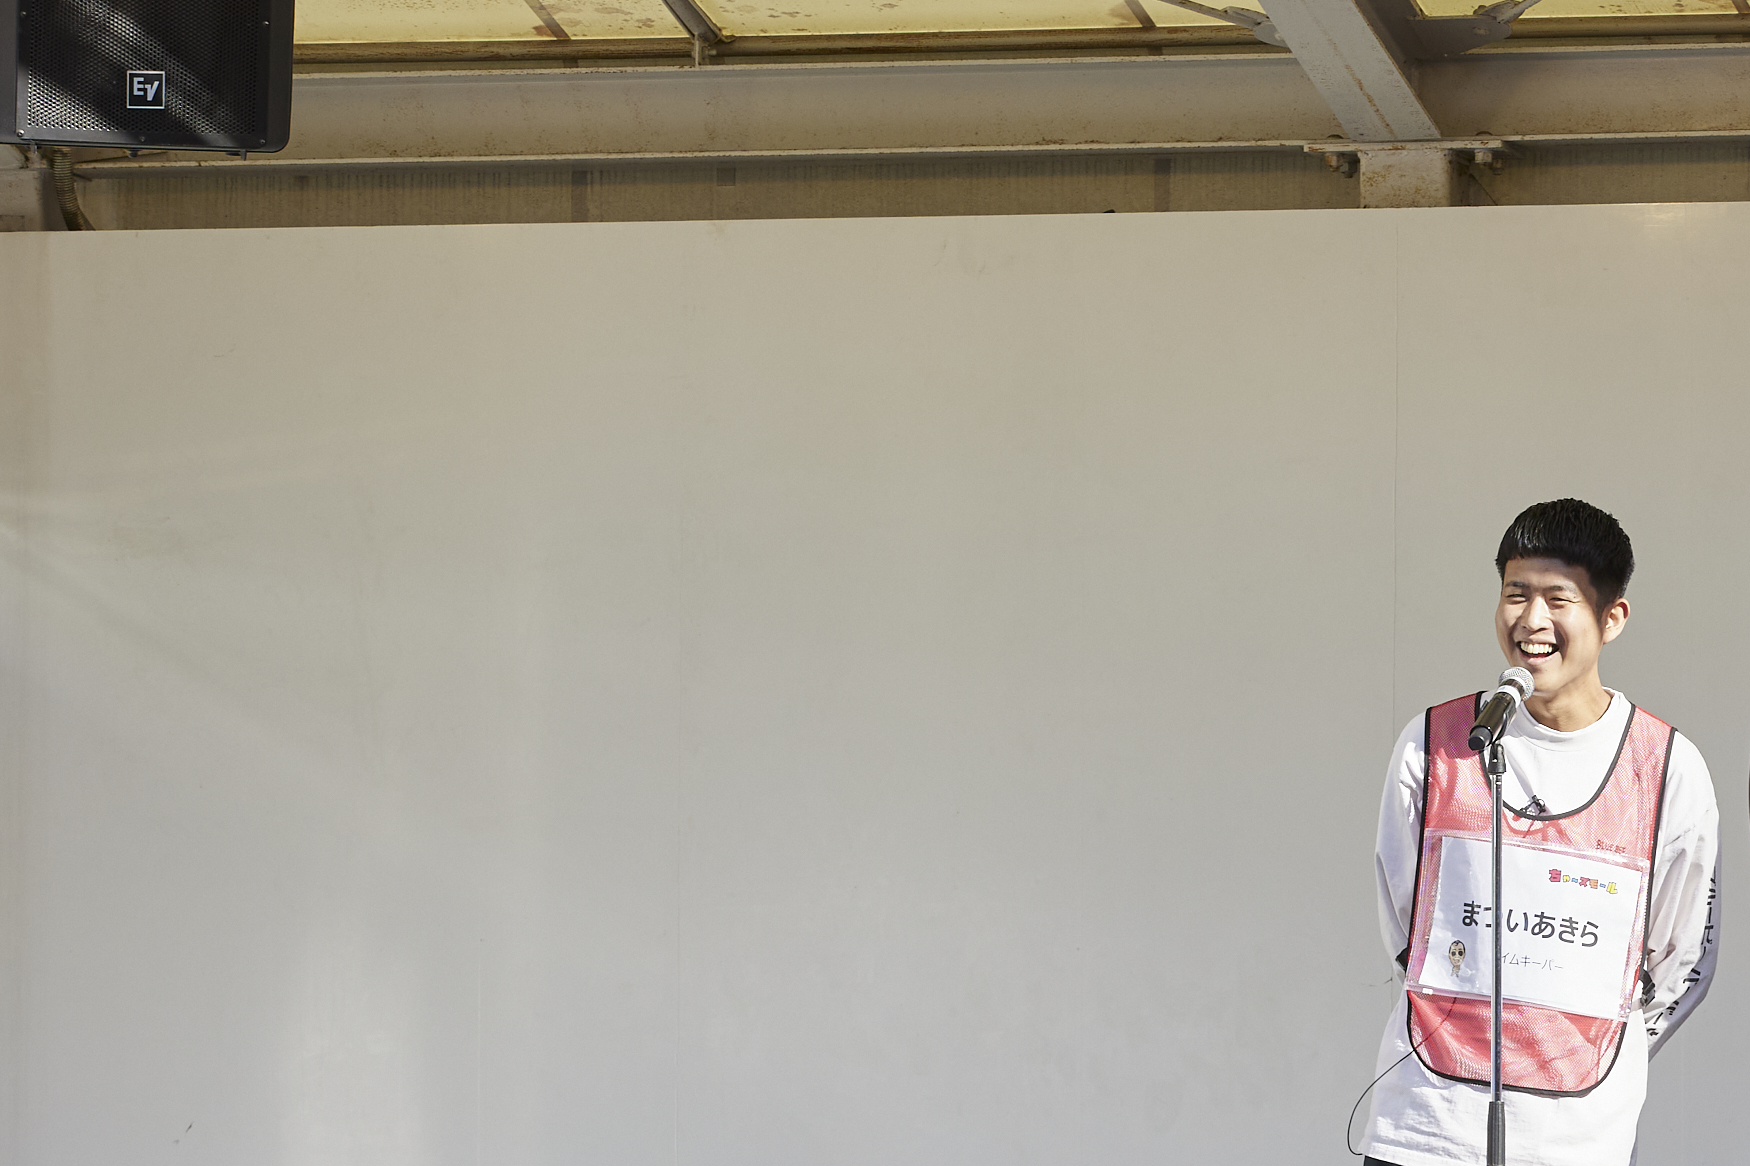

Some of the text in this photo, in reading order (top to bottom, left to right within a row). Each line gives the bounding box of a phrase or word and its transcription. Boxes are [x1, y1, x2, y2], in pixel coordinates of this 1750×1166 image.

[1501, 951, 1564, 971] イムキーパー
